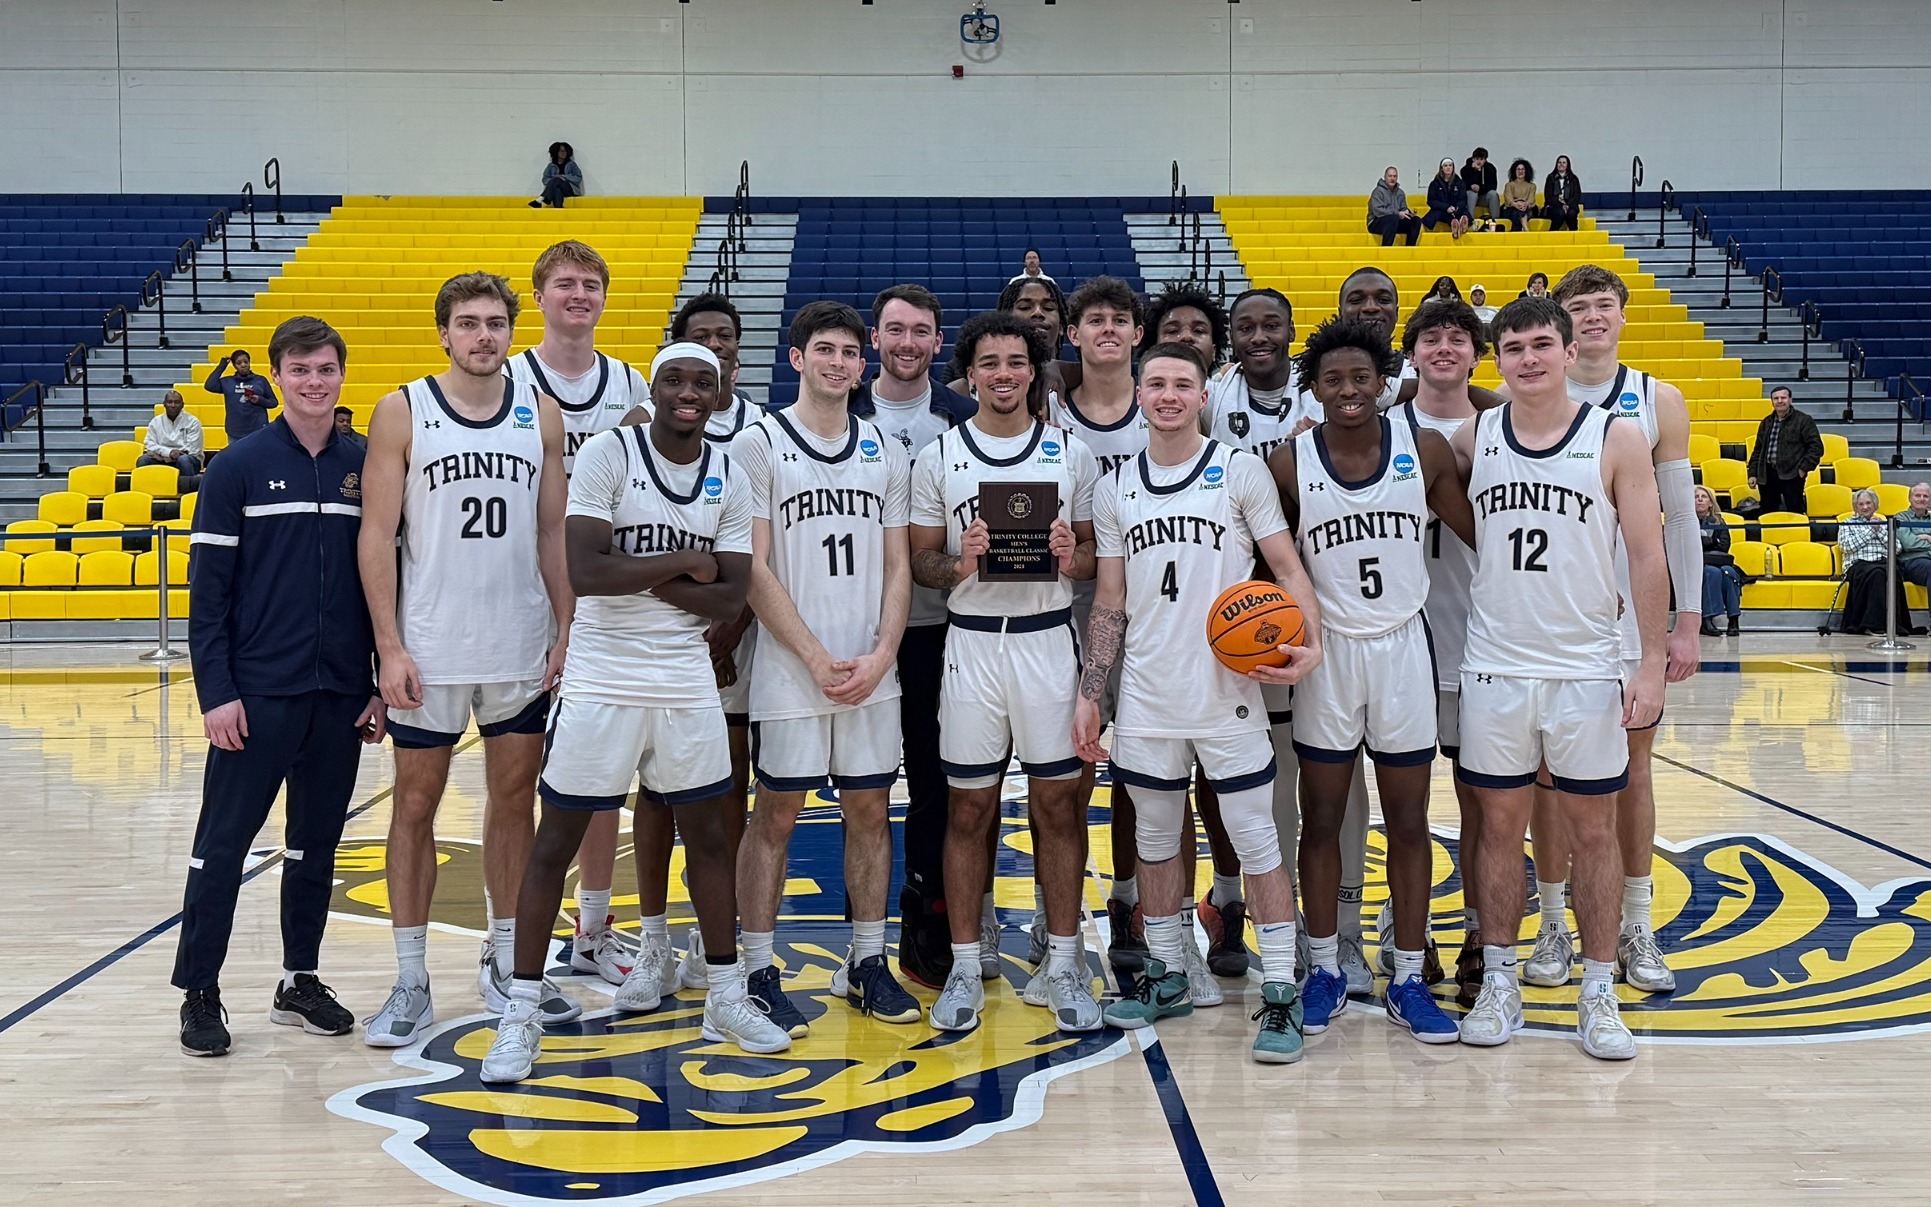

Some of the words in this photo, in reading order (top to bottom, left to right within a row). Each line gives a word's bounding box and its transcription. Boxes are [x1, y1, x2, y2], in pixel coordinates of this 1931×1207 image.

[423, 452, 537, 492] TRINITY
[461, 496, 507, 539] 20
[779, 488, 885, 531] TRINITY
[1475, 482, 1594, 524] TRINITY
[1308, 511, 1421, 555] TRINITY
[1507, 527, 1548, 572] 12
[822, 533, 855, 577] 11
[1161, 560, 1179, 602] 4
[1358, 557, 1383, 599] 5
[1221, 592, 1286, 622] Wilson
